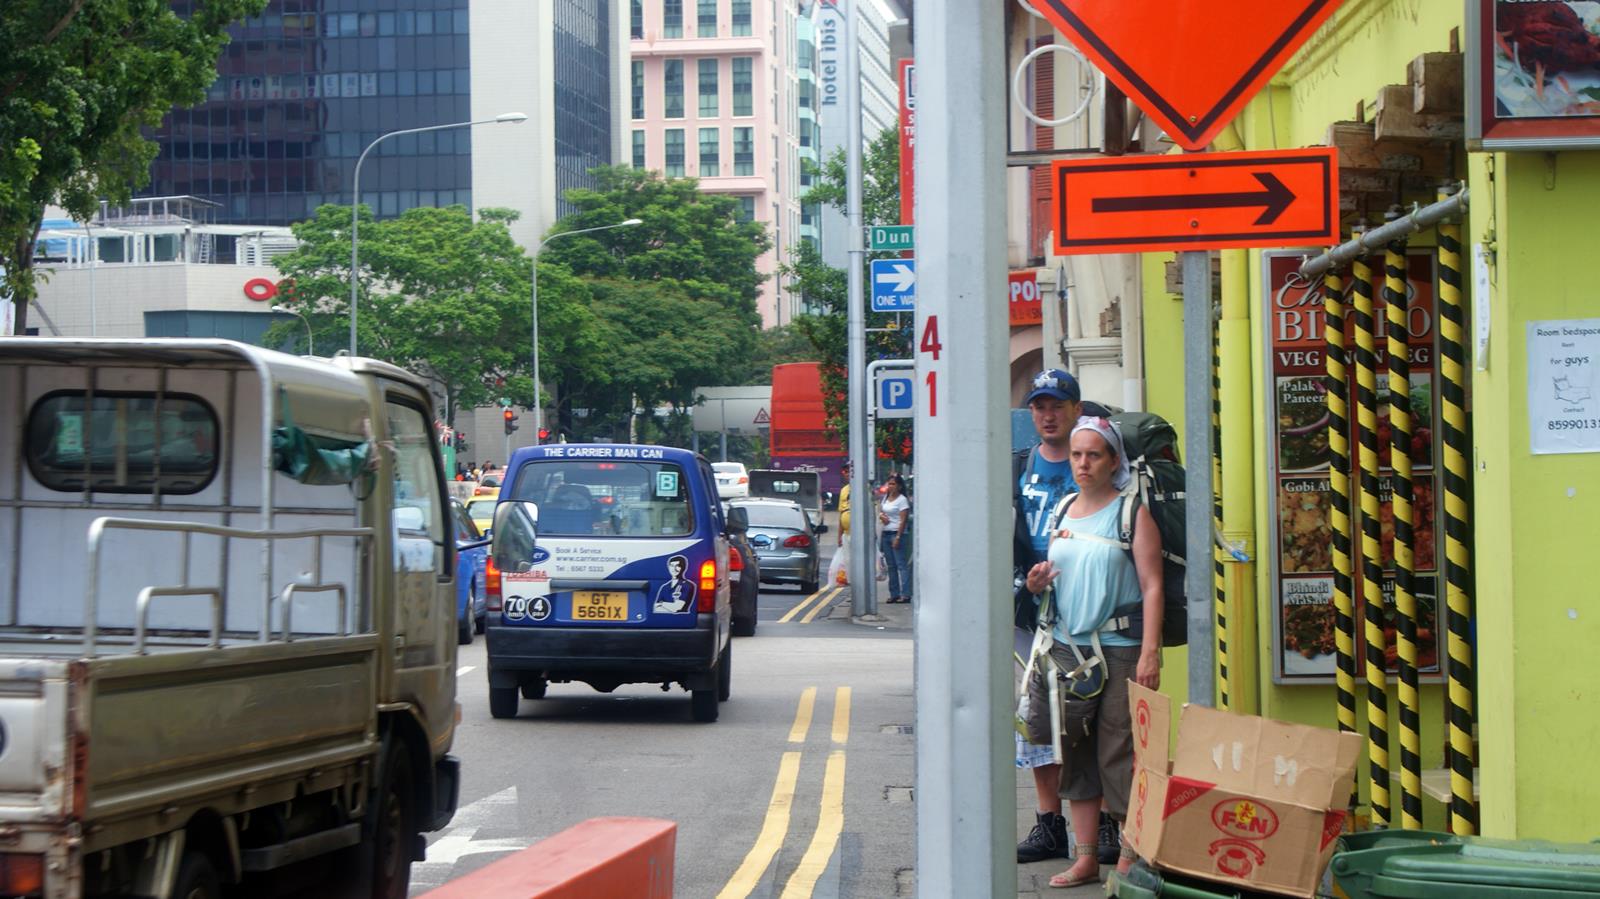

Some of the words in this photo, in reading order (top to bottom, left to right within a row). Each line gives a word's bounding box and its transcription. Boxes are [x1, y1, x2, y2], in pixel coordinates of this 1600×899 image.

[820, 19, 836, 51] ibis
[821, 60, 837, 106] hotel
[877, 295, 897, 306] ONE
[1279, 351, 1319, 366] VEG
[1565, 356, 1590, 367] guys
[1283, 380, 1316, 392] Palak
[889, 381, 906, 406] P
[1283, 393, 1325, 404] Paneer
[544, 448, 564, 457] THE
[567, 448, 612, 457] CARRIER
[615, 449, 637, 458] MAN
[641, 449, 663, 459] CAN
[661, 474, 674, 490] B
[1285, 481, 1314, 492] Gobi
[508, 598, 526, 611] 70
[534, 599, 543, 611] 4
[591, 593, 610, 605] GT
[578, 606, 622, 618] 5661X
